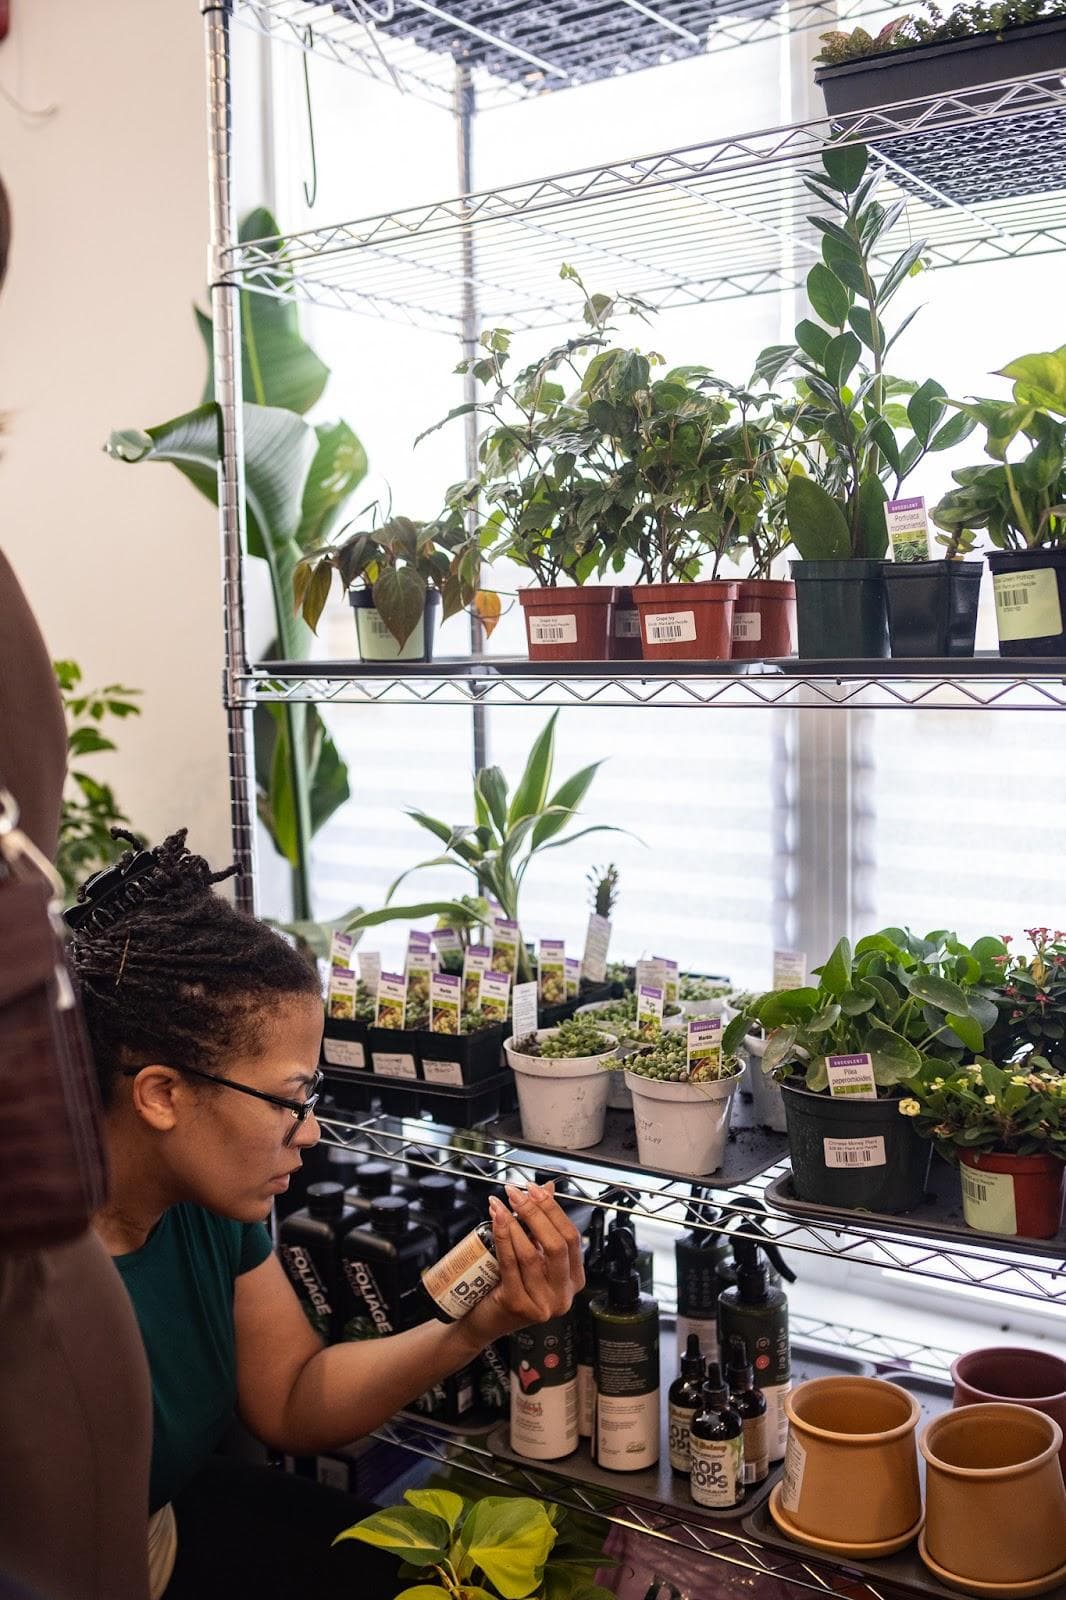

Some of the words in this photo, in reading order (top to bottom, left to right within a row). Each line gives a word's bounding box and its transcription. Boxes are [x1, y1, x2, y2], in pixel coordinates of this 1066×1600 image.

[831, 1074, 873, 1085] peperomioides
[833, 1058, 864, 1066] SUCCULENT
[289, 1245, 332, 1316] FOLIAGE
[350, 1262, 393, 1334] FOLIAGE
